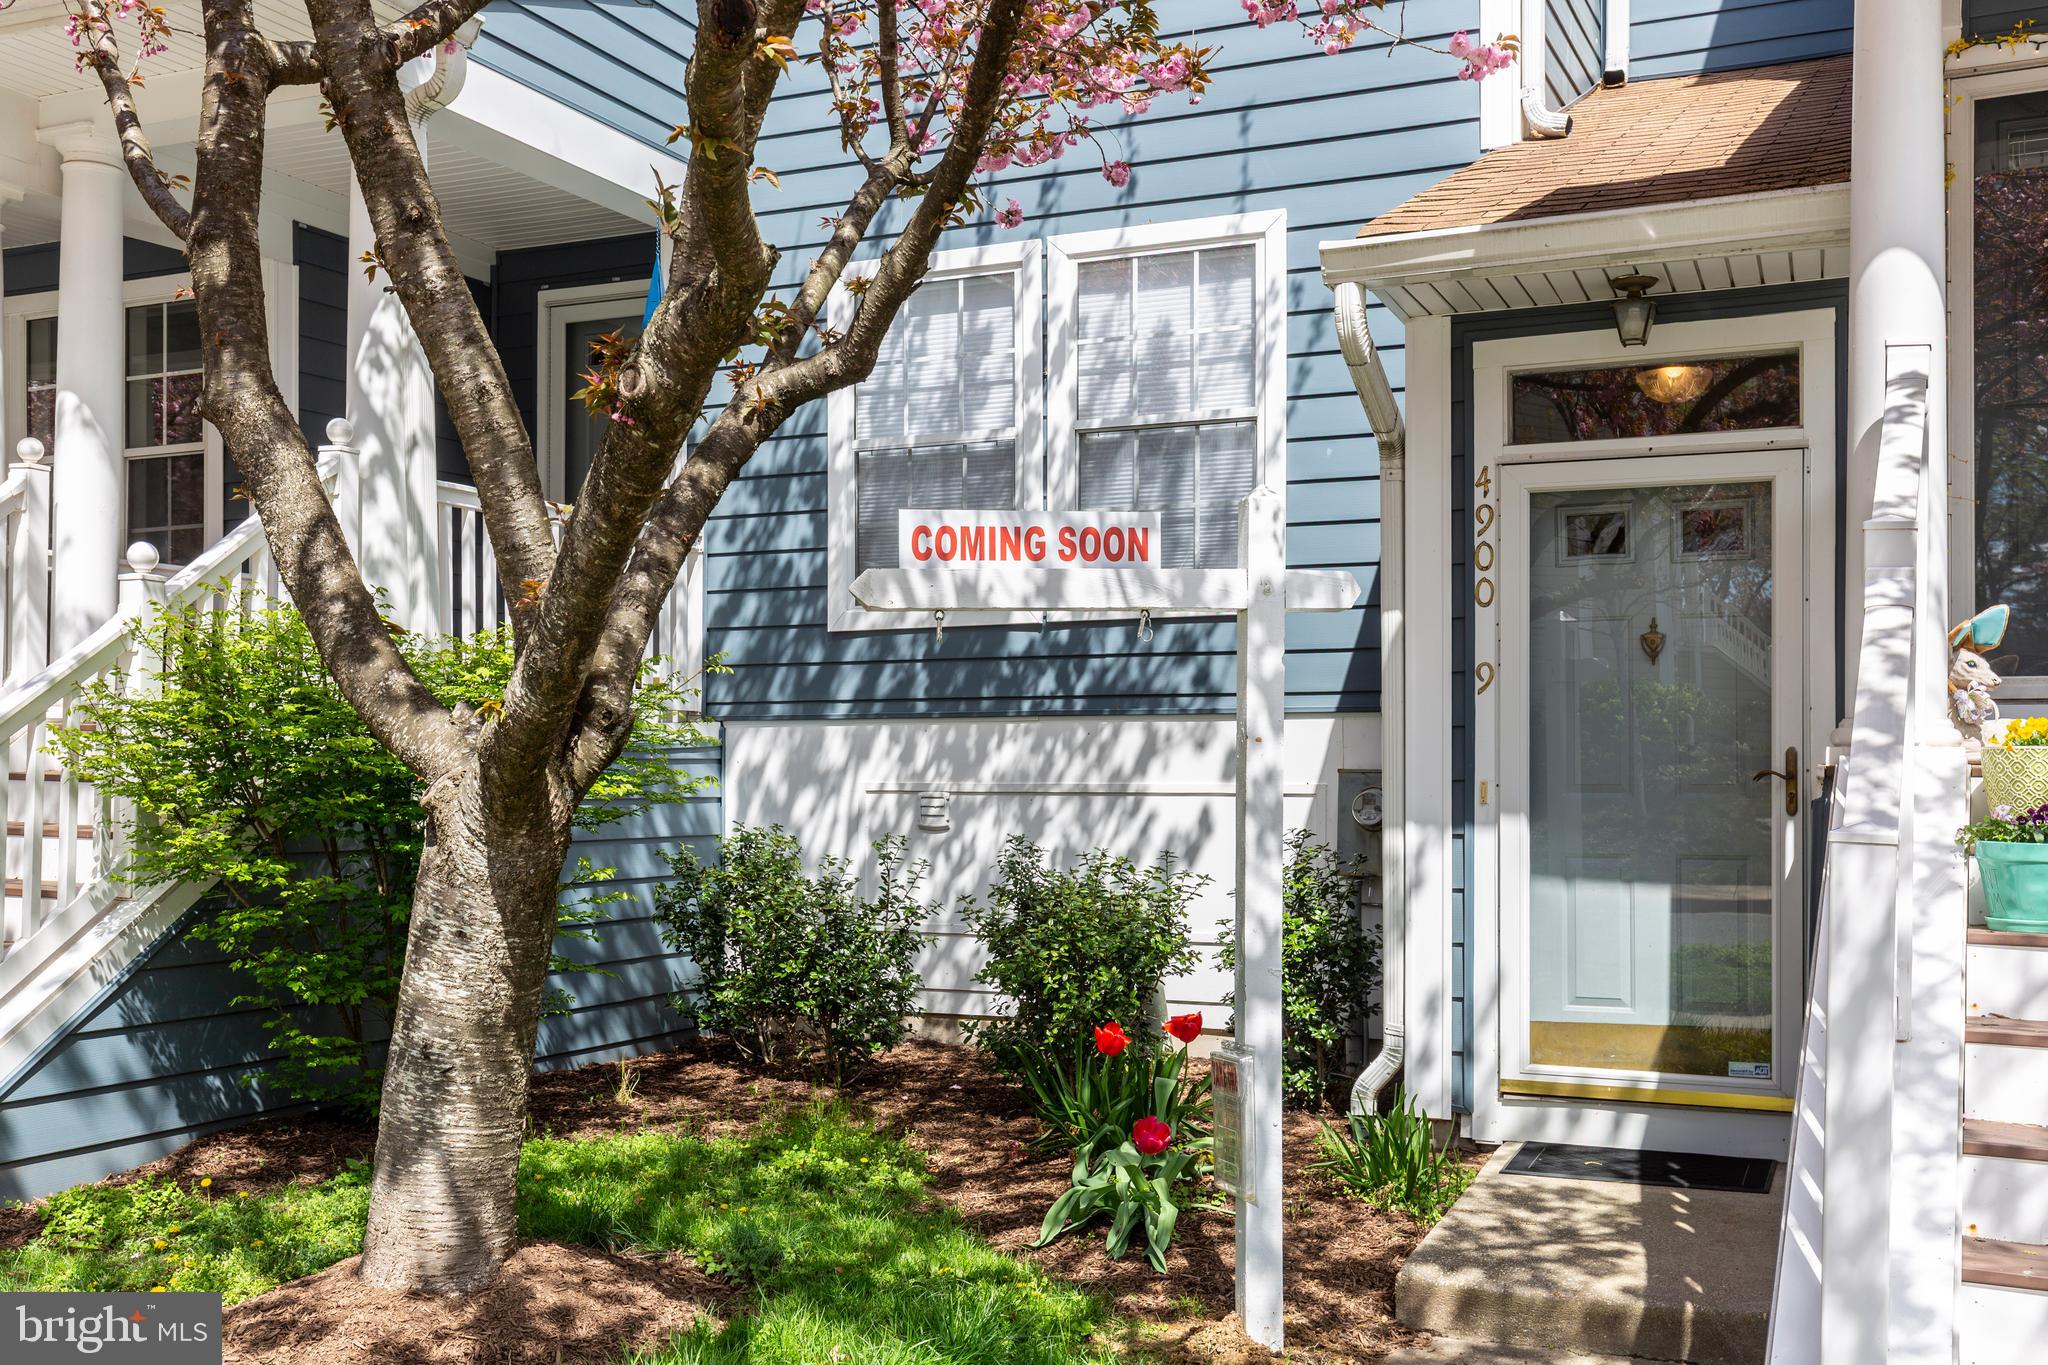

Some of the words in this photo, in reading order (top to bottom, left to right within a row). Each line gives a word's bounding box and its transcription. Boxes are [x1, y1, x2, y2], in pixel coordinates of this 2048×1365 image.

[911, 524, 1047, 562] COMING
[1058, 526, 1149, 562] SOON
[1475, 465, 1495, 608] 4900
[1475, 661, 1495, 695] 9
